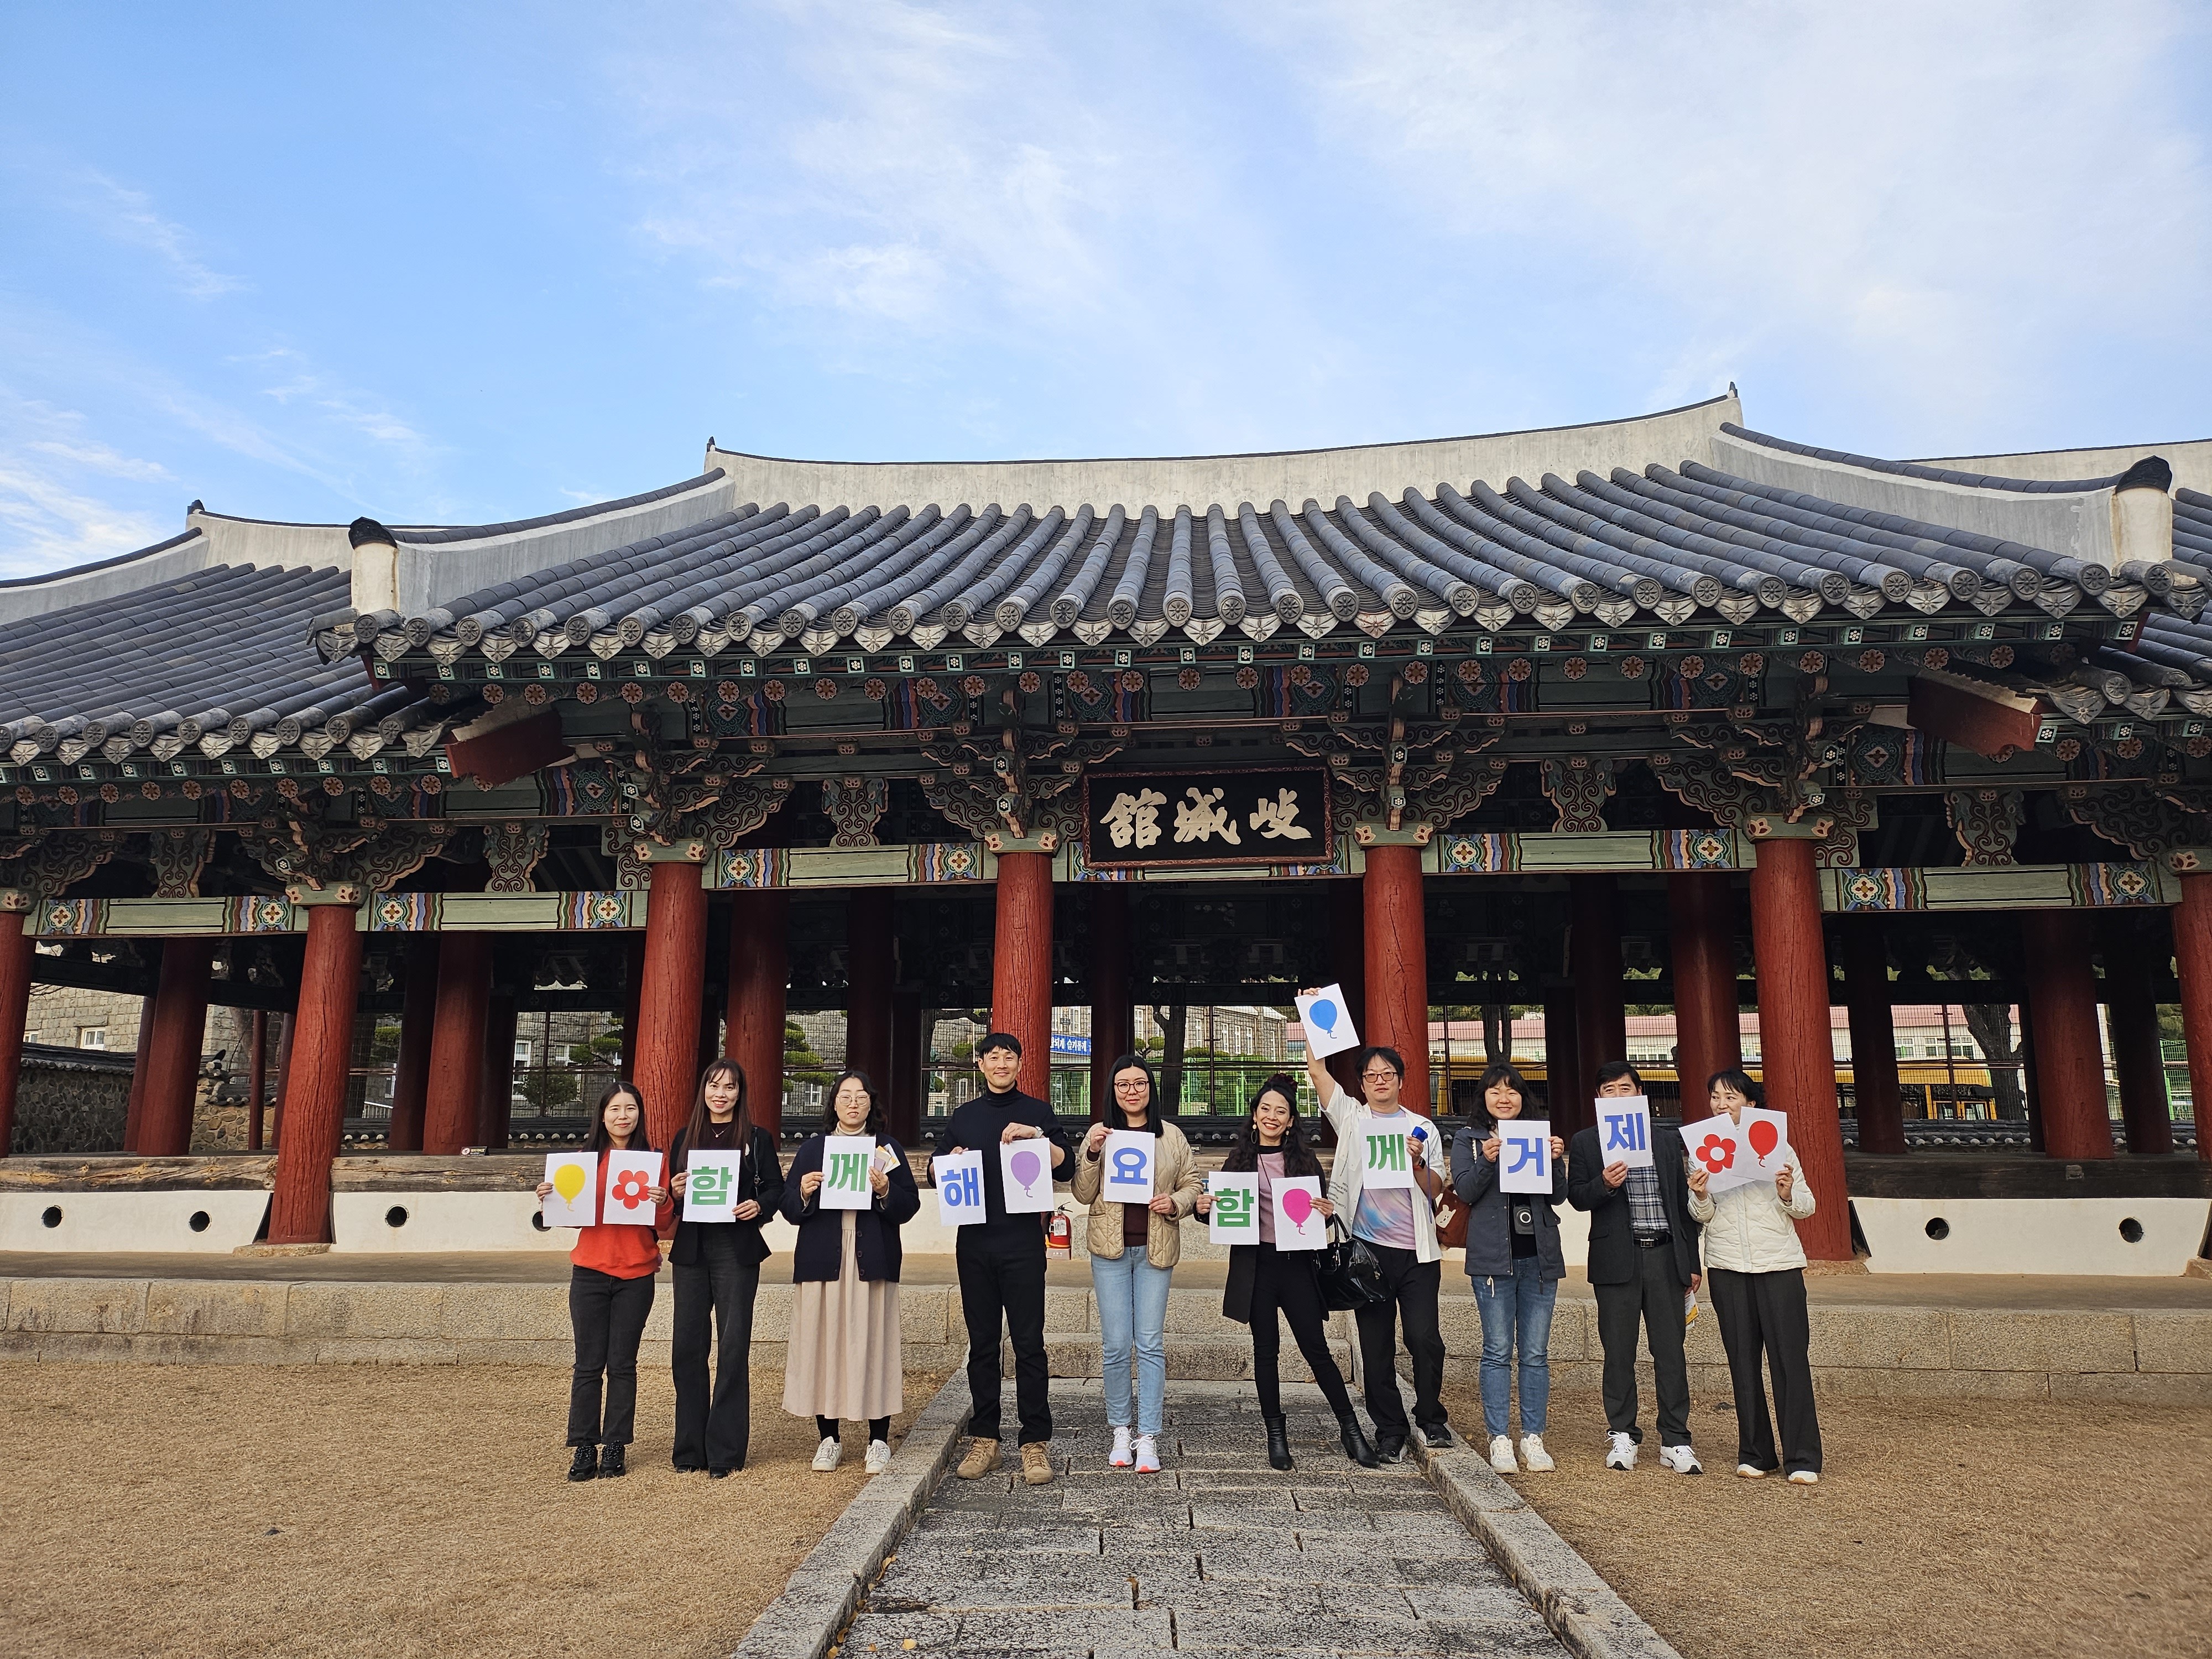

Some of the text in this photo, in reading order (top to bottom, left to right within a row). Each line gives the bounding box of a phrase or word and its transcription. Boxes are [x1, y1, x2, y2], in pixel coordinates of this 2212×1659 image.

[1067, 1039, 1087, 1052] 슬기롭게
[1604, 1112, 1646, 1151] 제
[828, 1153, 867, 1192] 께
[1110, 1147, 1148, 1185] 요
[1367, 1134, 1406, 1172] 께
[1506, 1137, 1545, 1176] 거
[691, 1165, 733, 1206] 함
[941, 1167, 980, 1207] 해
[1214, 1188, 1255, 1228] 함
